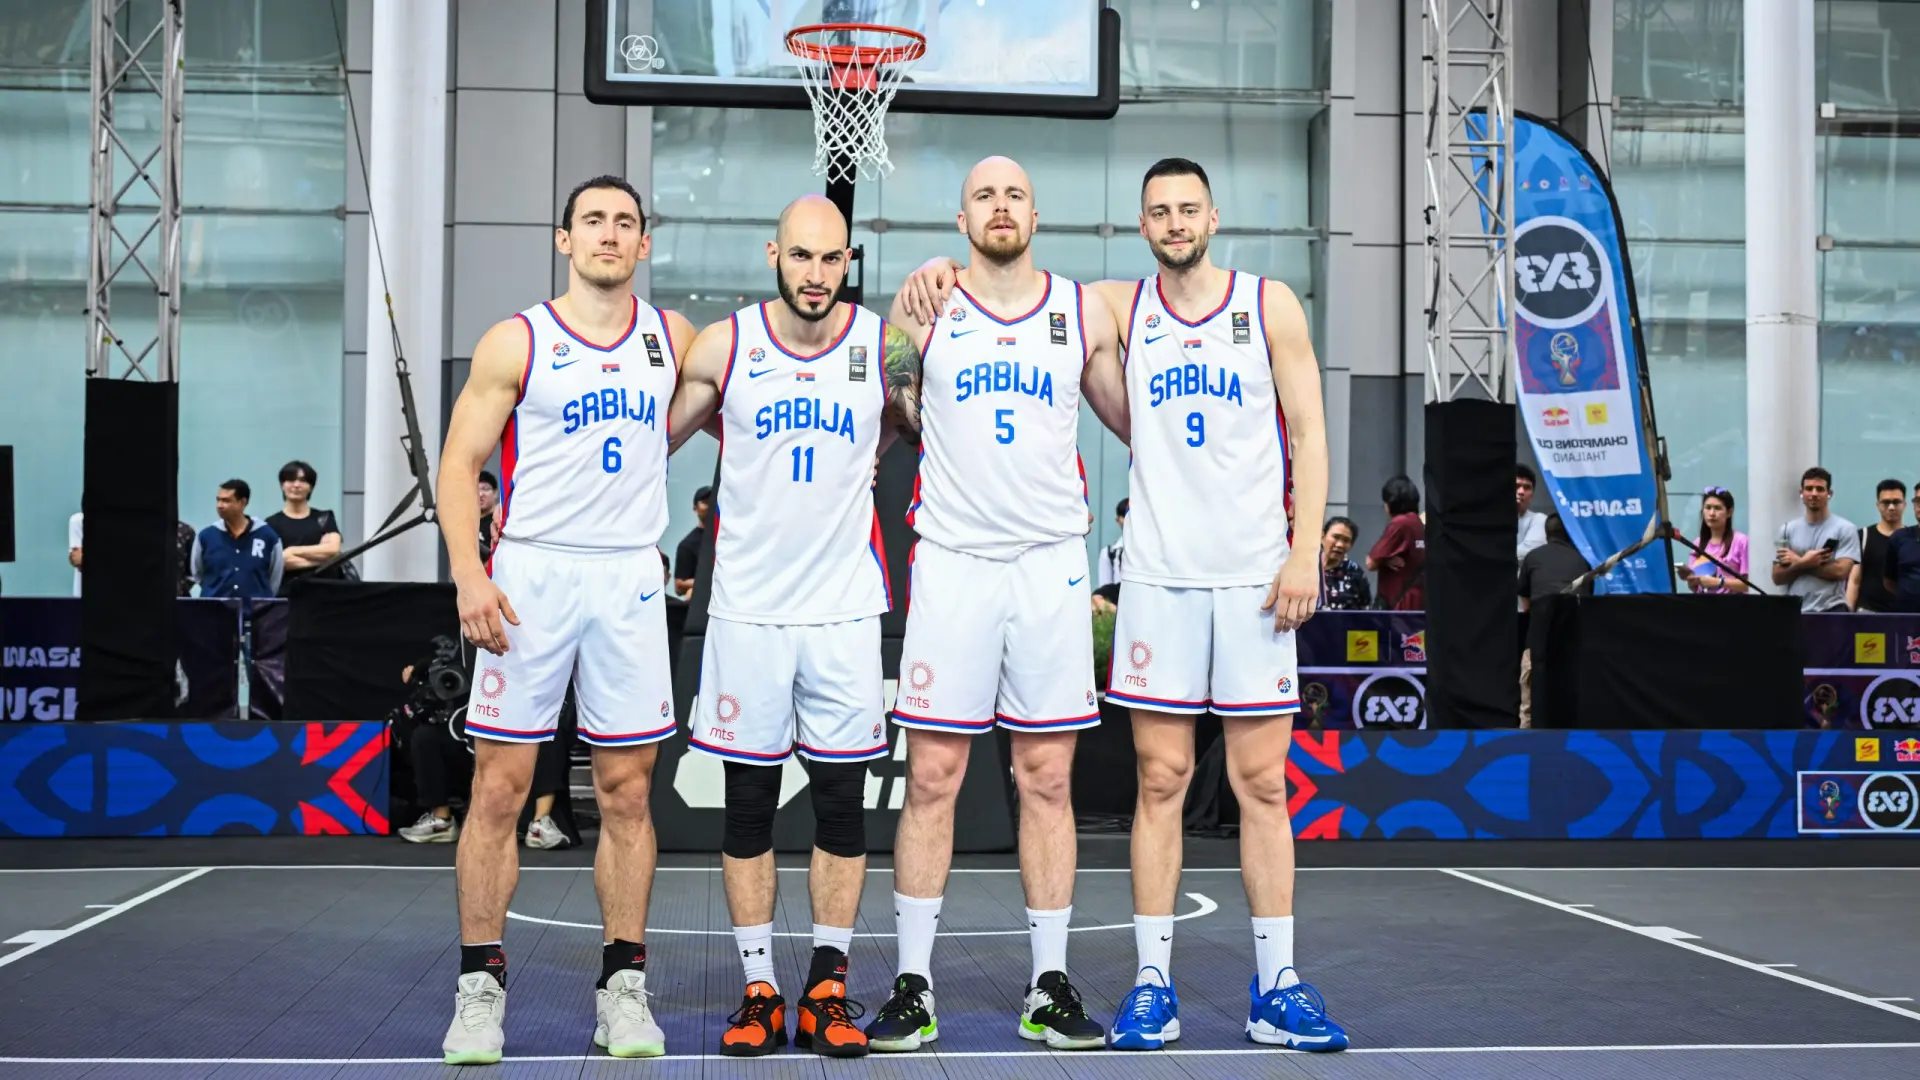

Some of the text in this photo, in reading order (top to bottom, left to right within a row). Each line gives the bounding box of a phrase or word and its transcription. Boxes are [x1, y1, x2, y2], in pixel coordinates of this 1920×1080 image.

[956, 361, 1053, 407] SRBIJA
[1149, 364, 1243, 407] SRBIJA
[562, 388, 656, 434] SRBIJA
[755, 397, 855, 444] SRBIJA
[995, 409, 1015, 444] 5
[1186, 412, 1205, 447] 9
[602, 437, 622, 473] 6
[792, 446, 814, 482] 11
[252, 538, 265, 558] R
[1124, 675, 1147, 688] mts
[475, 704, 500, 718] mts
[905, 696, 930, 709] mts
[709, 727, 735, 741] mts
